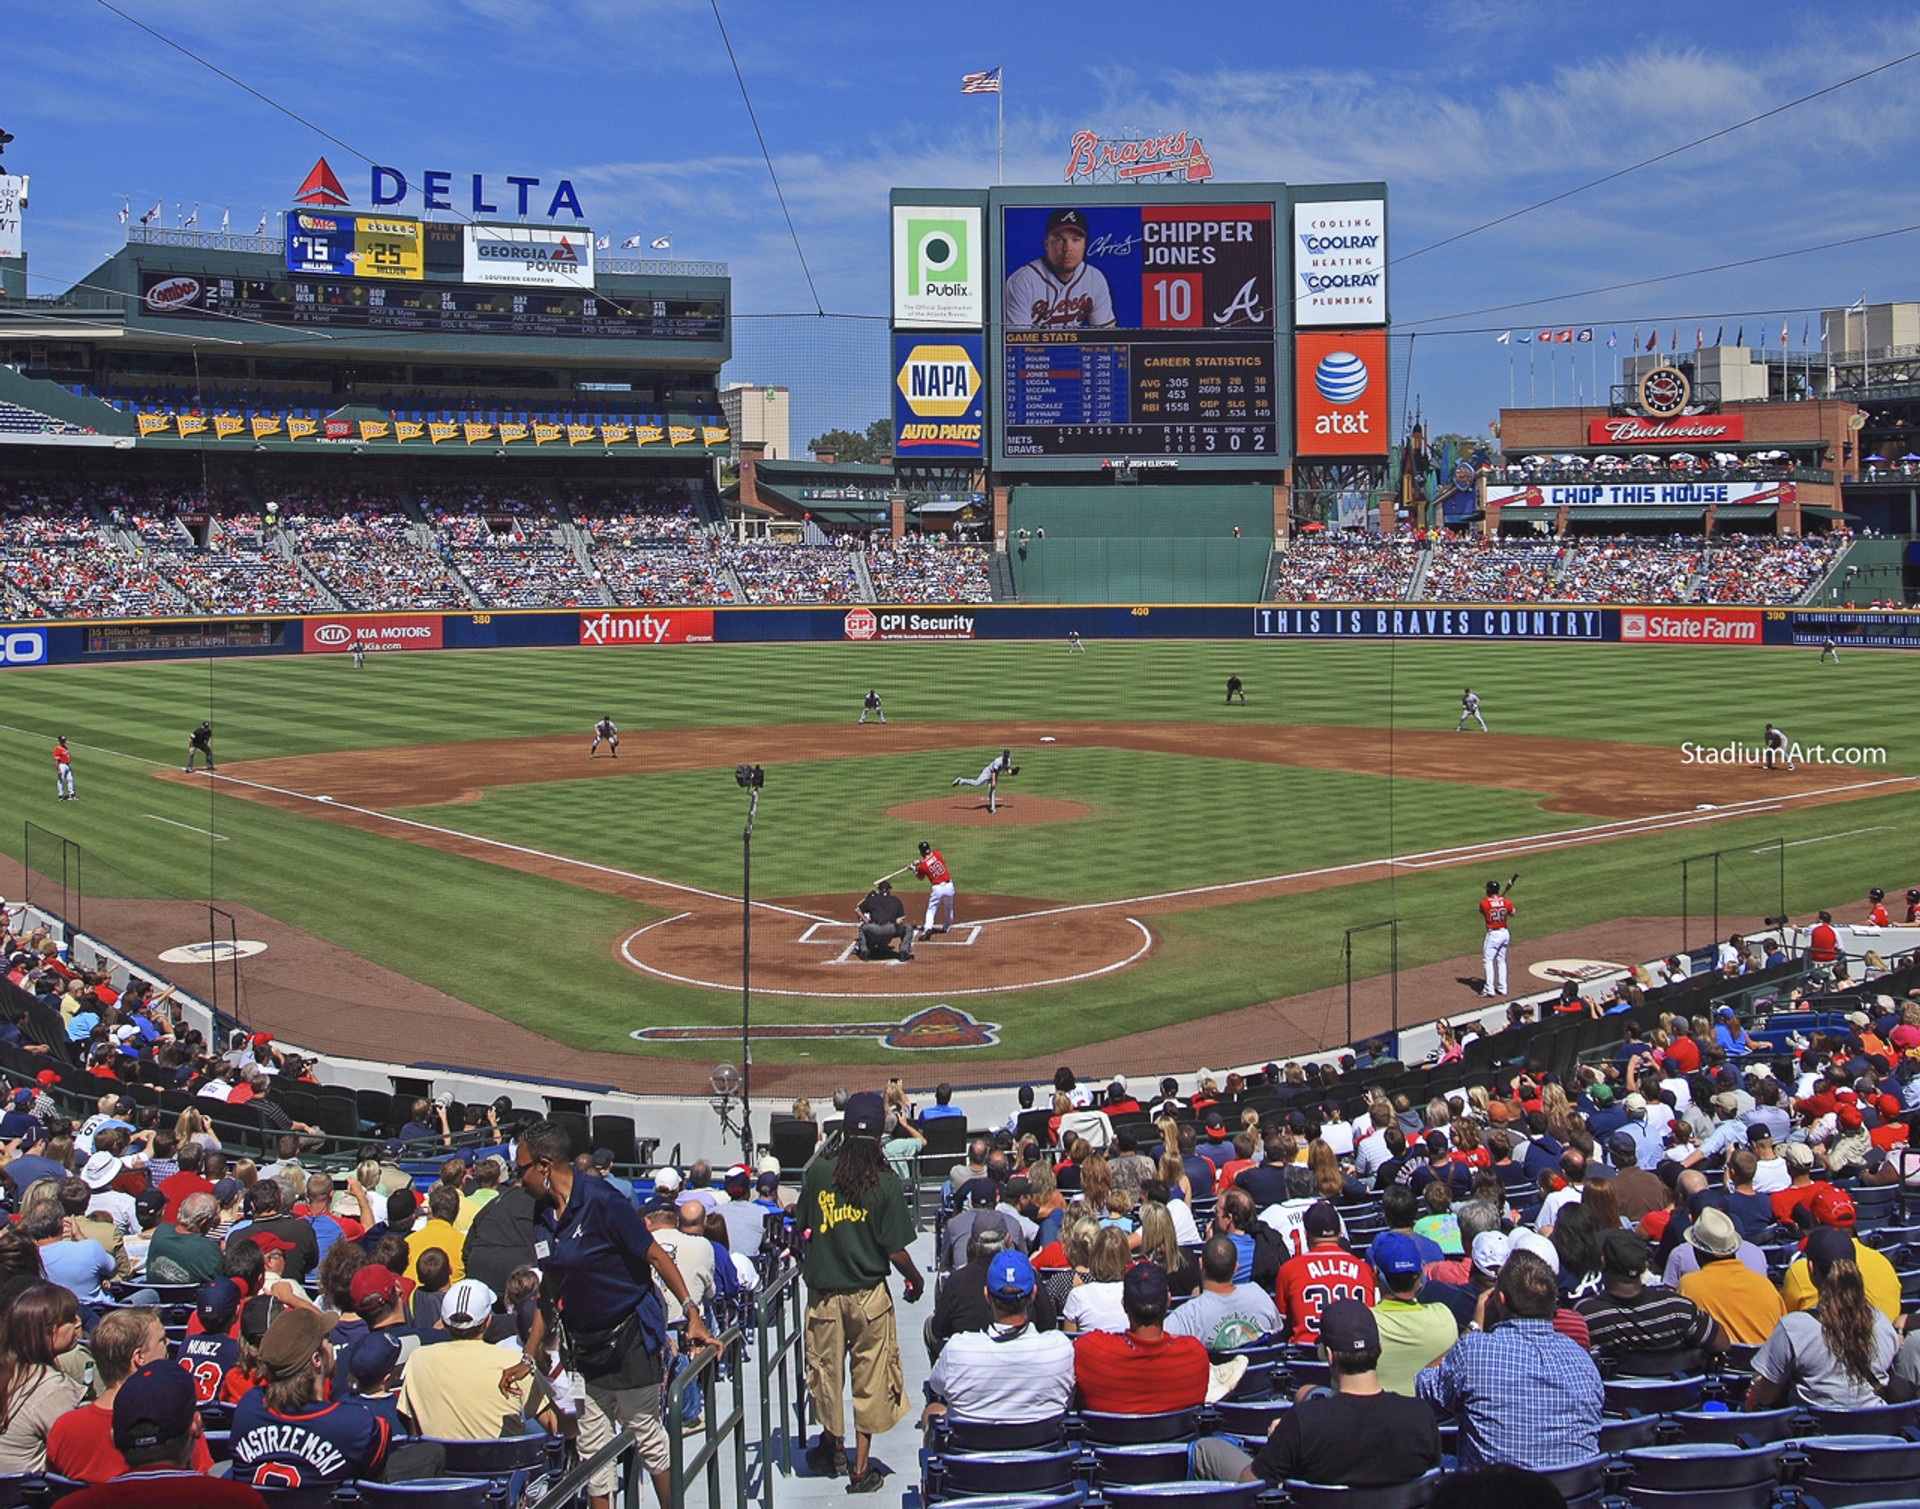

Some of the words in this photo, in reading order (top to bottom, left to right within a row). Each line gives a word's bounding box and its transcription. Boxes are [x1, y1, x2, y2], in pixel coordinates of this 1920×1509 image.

[1065, 130, 1189, 182] Braves
[371, 165, 585, 218] DELTA
[1311, 219, 1371, 229] COOLING
[1143, 222, 1254, 243] CHIPPER
[1307, 235, 1379, 251] COOLRAY
[479, 246, 548, 260] GEORGIA
[1144, 246, 1217, 265] JONES
[526, 260, 579, 274] POWER
[1312, 258, 1372, 267] HEATING
[484, 275, 521, 283] SOUTHERN
[522, 276, 555, 284] COMPANY
[1308, 273, 1380, 288] COOLRAY
[151, 279, 197, 303] Combos
[926, 283, 968, 297] Publix
[1153, 279, 1191, 322] 10
[1312, 296, 1372, 306] PLUMBING
[1006, 333, 1039, 342] GAME
[1042, 333, 1078, 342] STATS
[1144, 358, 1191, 367] CAREER
[1195, 357, 1261, 366] STATISTICS
[912, 365, 967, 397] NAPA
[1140, 380, 1160, 388] AVG
[1165, 378, 1189, 388] .305
[1199, 377, 1221, 385] HITS
[1144, 391, 1159, 399] HR
[1167, 390, 1186, 399] 453
[1142, 404, 1159, 412] RBI
[1165, 403, 1189, 412] 1558
[1227, 400, 1246, 408] SLG
[1315, 410, 1369, 434] at&t
[900, 424, 939, 440] AUTO
[939, 424, 982, 440] PARTS
[1164, 426, 1170, 434] R
[1604, 421, 1726, 441] Budweiser
[1008, 446, 1043, 454] BRAVES
[1205, 435, 1215, 451] 3
[1230, 435, 1240, 451] 0
[1254, 435, 1264, 450] 2
[1552, 485, 1604, 504] CHOP
[1611, 485, 1655, 503] THIS
[1662, 484, 1728, 503] HOUSE
[1131, 607, 1149, 616] 400
[1766, 611, 1786, 621] 390
[473, 615, 491, 624] 380
[848, 620, 873, 630] CPI
[880, 615, 906, 630] CPI
[910, 614, 974, 632] Security
[1261, 610, 1320, 633] THIS
[1336, 610, 1361, 633] IS
[1376, 610, 1470, 634] BRAVES
[1484, 611, 1594, 636] COUNTRY
[103, 628, 130, 636] Dillon
[132, 627, 150, 635] Gee
[321, 629, 345, 640] KIA
[356, 628, 378, 639] KIA
[380, 627, 431, 638] MOTORS
[583, 613, 671, 644] xfinity
[1307, 1259, 1359, 1279] ALLEN
[186, 1339, 221, 1356] NUNEZ
[235, 1425, 346, 1476] YASTRZEMSKI
